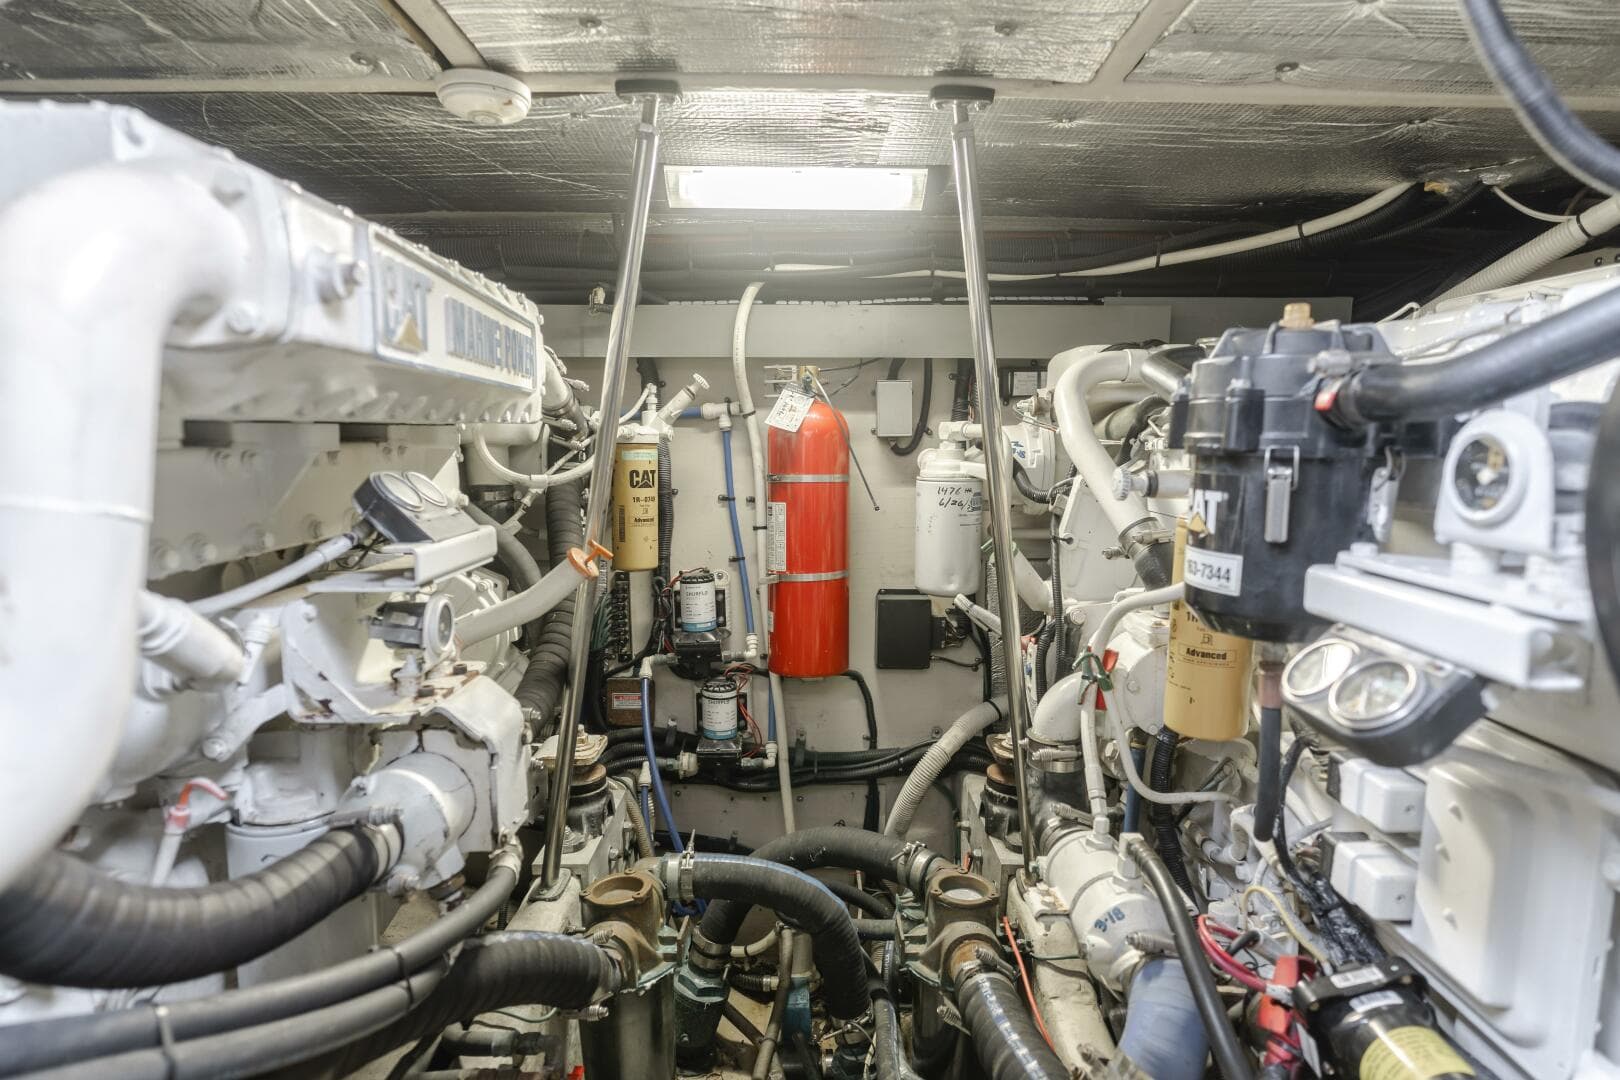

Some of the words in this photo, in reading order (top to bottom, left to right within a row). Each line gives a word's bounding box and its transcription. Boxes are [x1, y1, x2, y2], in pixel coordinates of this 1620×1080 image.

[629, 469, 656, 488] CAT
[1187, 487, 1222, 537] AT
[1185, 647, 1227, 660] Advanced
